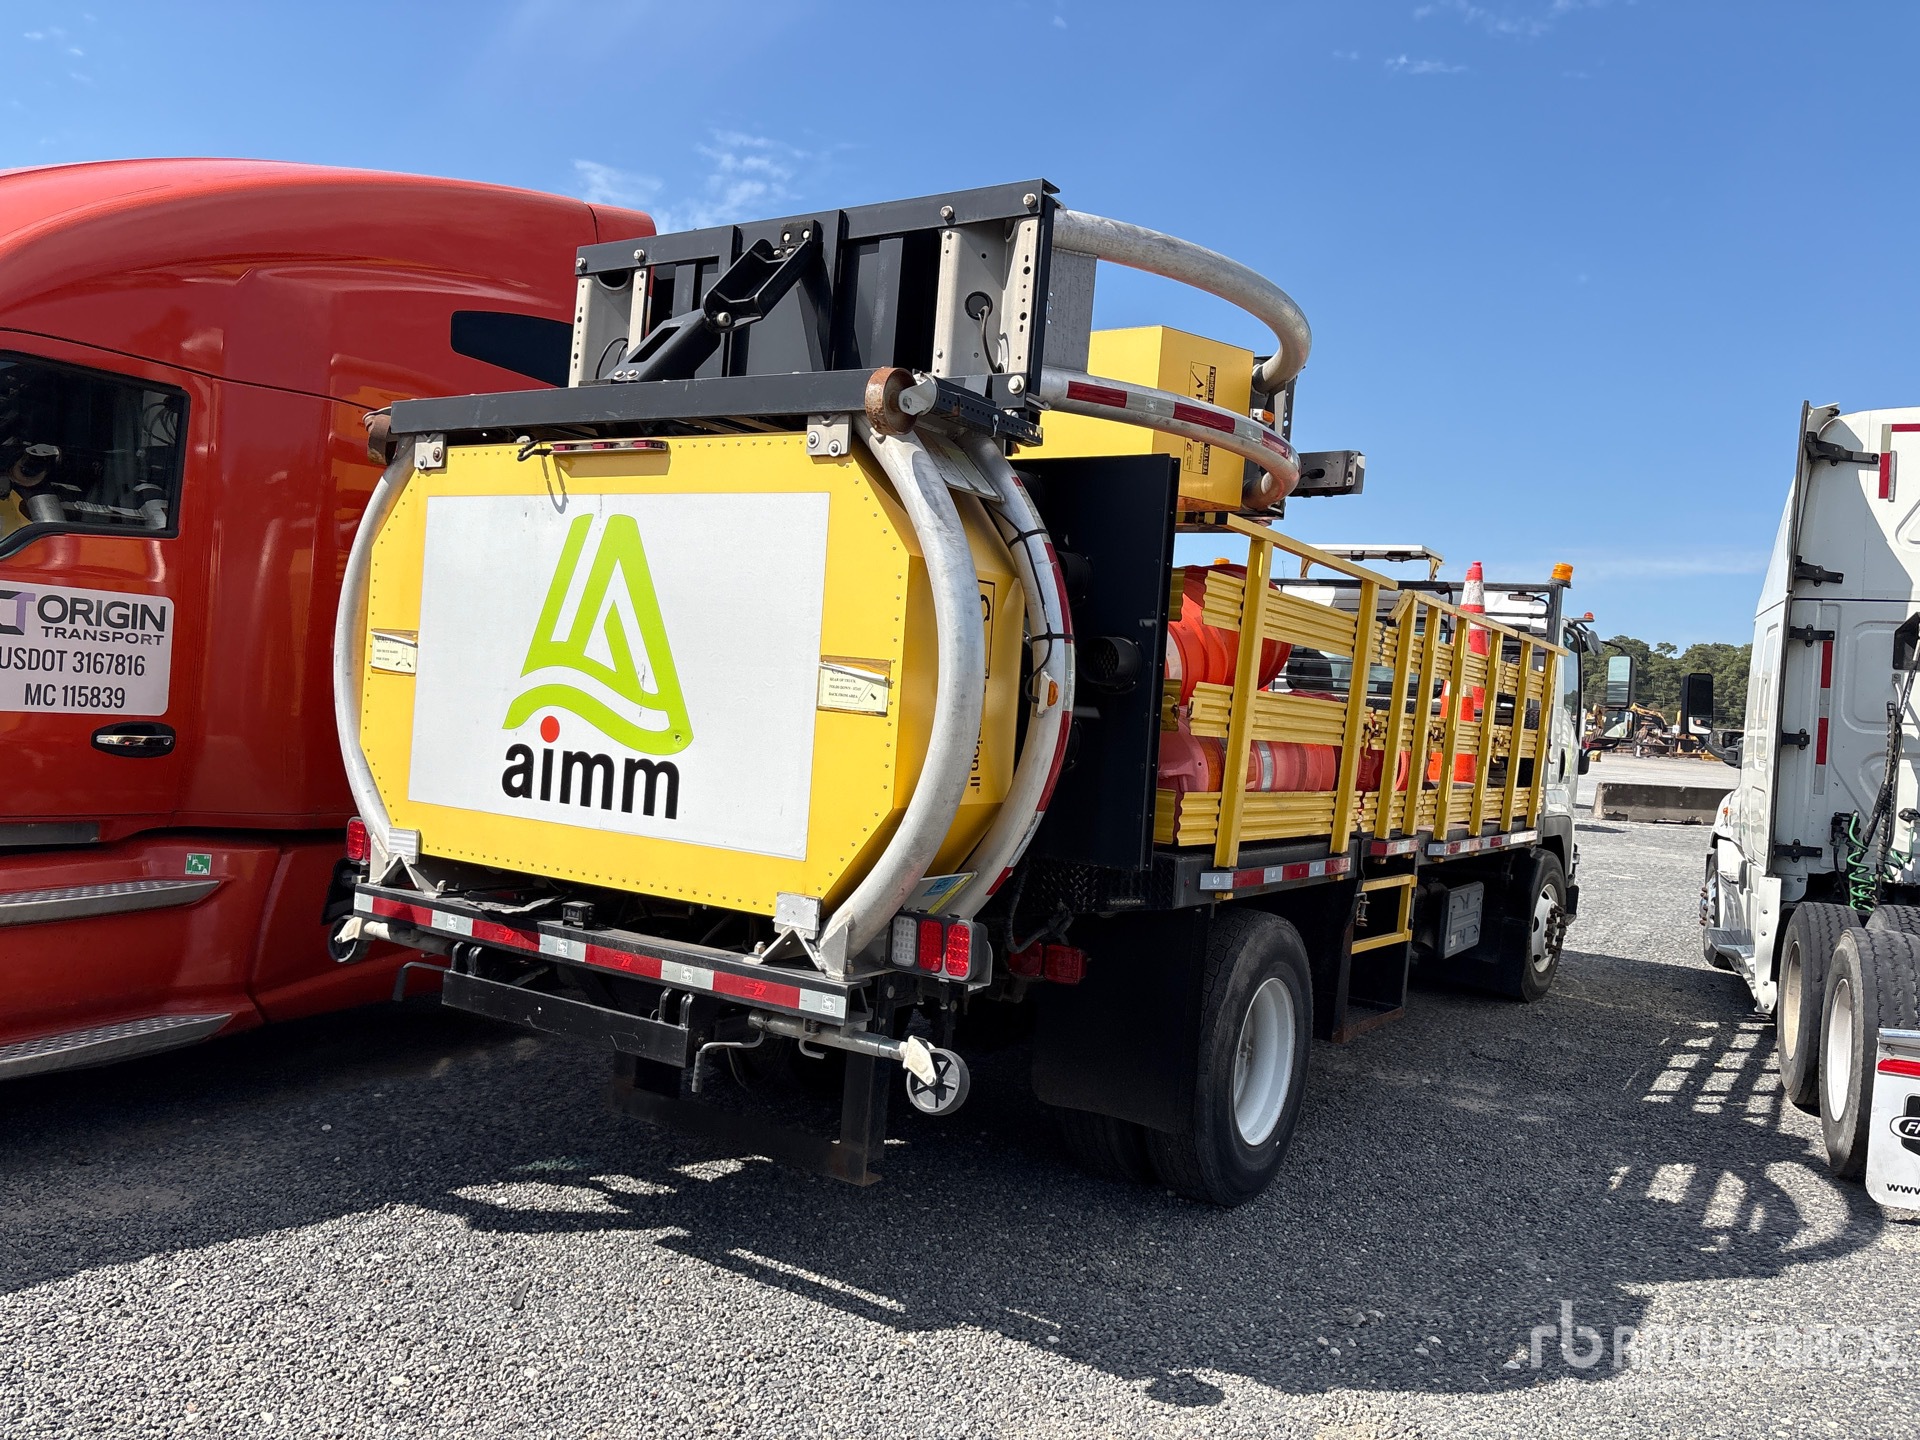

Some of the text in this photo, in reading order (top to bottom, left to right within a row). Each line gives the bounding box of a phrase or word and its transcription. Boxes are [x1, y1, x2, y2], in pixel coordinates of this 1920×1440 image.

[1208, 367, 1216, 399] ELIGIBLE
[37, 594, 167, 632] ORIGIN
[41, 626, 165, 646] TRANSPORT
[0, 647, 146, 676] USDOT 3167816
[24, 683, 126, 709] MC 115839
[501, 715, 680, 820] aimm
